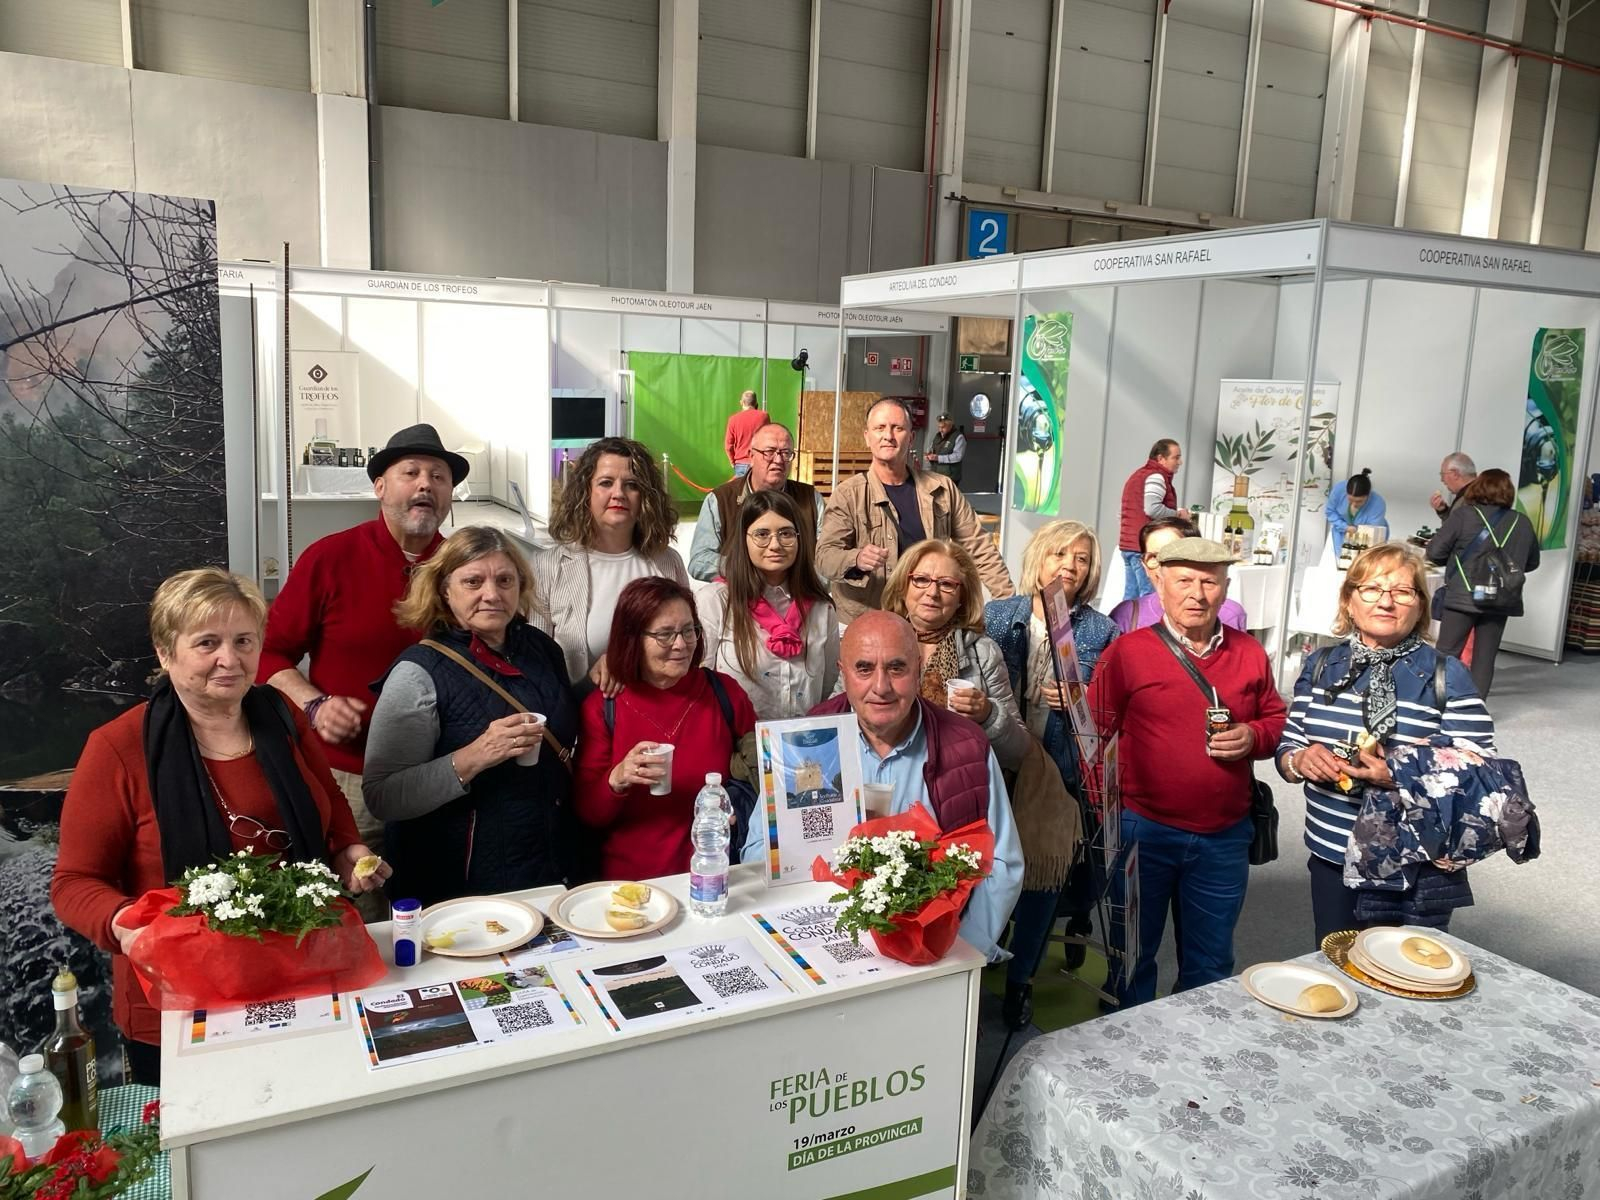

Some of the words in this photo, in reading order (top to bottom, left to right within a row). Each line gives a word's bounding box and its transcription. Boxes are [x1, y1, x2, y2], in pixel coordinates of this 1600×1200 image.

[979, 218, 999, 254] 2
[1094, 254, 1153, 271] COOPERATIVA
[1154, 252, 1174, 266] SAN
[1176, 248, 1212, 264] RAFAEL
[1419, 248, 1481, 268] COOPERATIVA
[1482, 255, 1500, 270] SAN
[1501, 257, 1533, 274] RAFAEL
[411, 282, 422, 292] DE
[423, 283, 440, 293] LOS
[442, 284, 478, 295] TROFEOS
[889, 279, 917, 292] ARTEOLIVA
[917, 278, 928, 290] DEL
[928, 275, 958, 288] CONDADO
[611, 296, 658, 307] PHOTOMATÓN
[658, 300, 695, 310] OLEOTOUR
[858, 313, 888, 322] OLEOTOUR
[300, 392, 339, 401] TROFEOS
[1286, 386, 1303, 395] Virge
[782, 922, 835, 935] COMARC
[370, 997, 406, 1006] Condado
[770, 1067, 830, 1100] FERIA
[835, 1072, 848, 1083] DE
[769, 1100, 788, 1112] LOS
[789, 1064, 926, 1125] PUEBLOS
[793, 1125, 856, 1150] 19/marzo
[793, 1151, 815, 1167] DÍA
[817, 1145, 835, 1160] DE
[836, 1141, 852, 1154] LA
[854, 1122, 918, 1149] PROVINCIA
